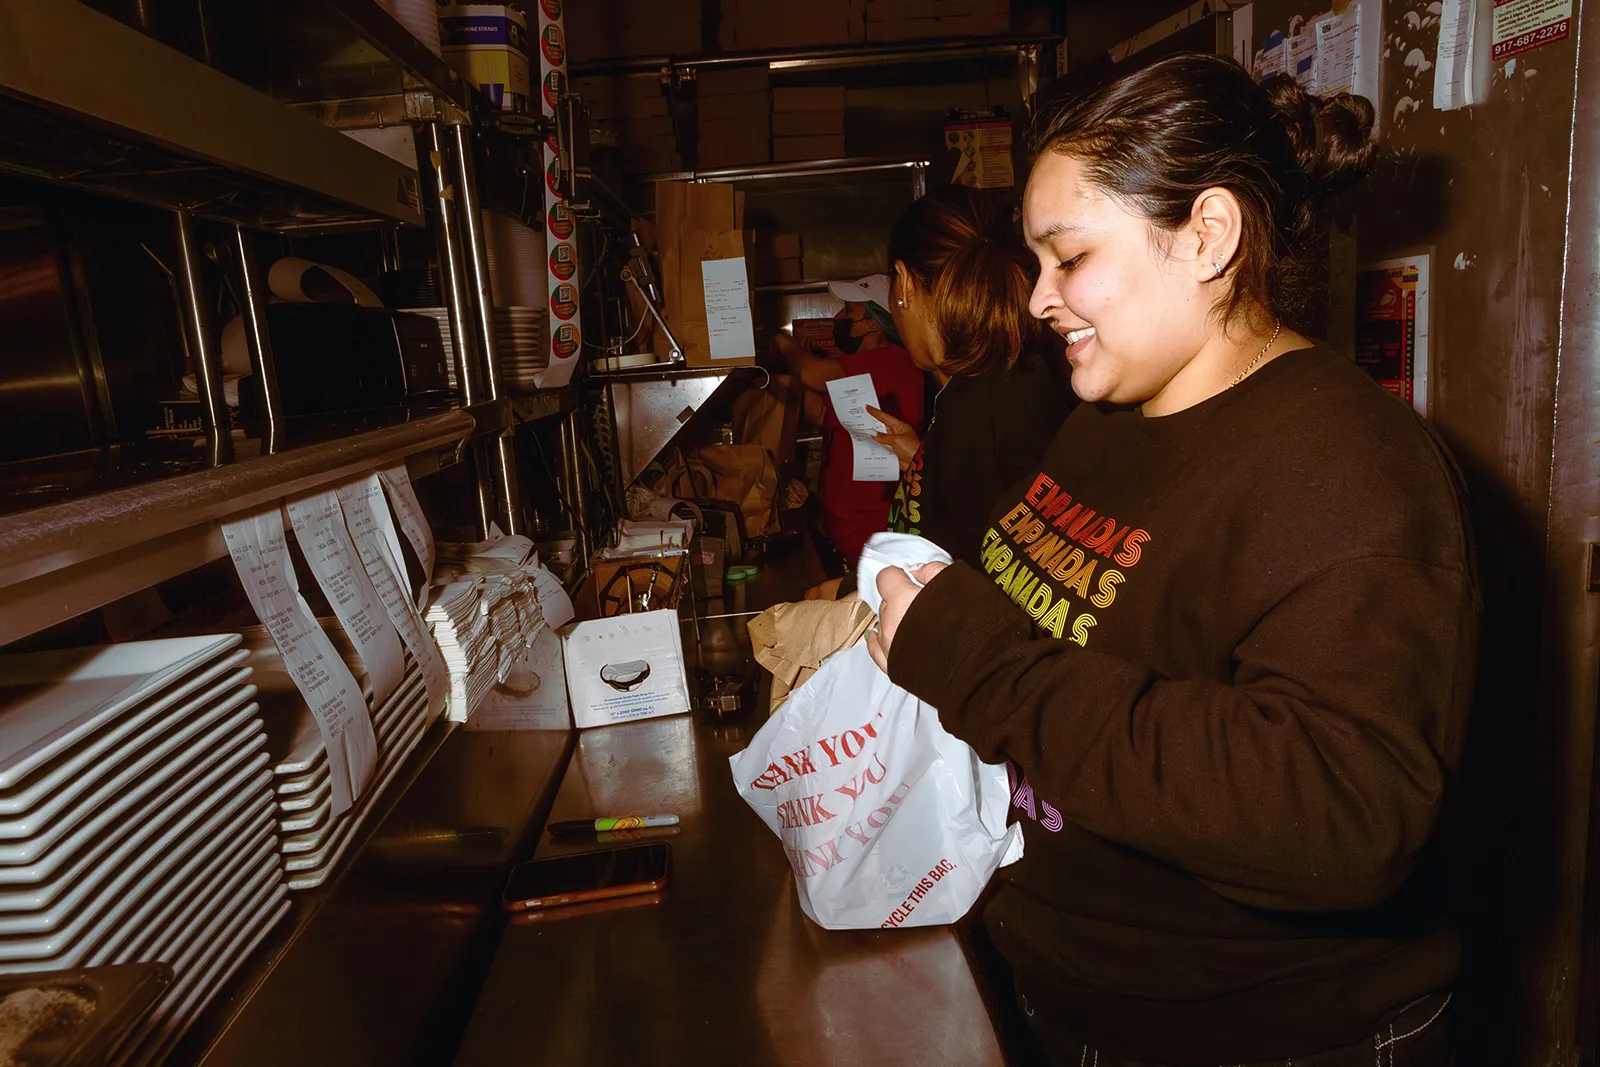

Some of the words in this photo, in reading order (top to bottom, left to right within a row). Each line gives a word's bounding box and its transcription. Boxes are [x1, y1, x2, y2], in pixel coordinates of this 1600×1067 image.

[1495, 22, 1567, 55] 917-687-2276
[999, 502, 1126, 608] EMPANADAS
[1025, 472, 1151, 567] EMPANADAS
[981, 527, 1097, 647] EMPANADAS
[908, 878, 934, 904] THIS
[928, 858, 958, 882] BAG.
